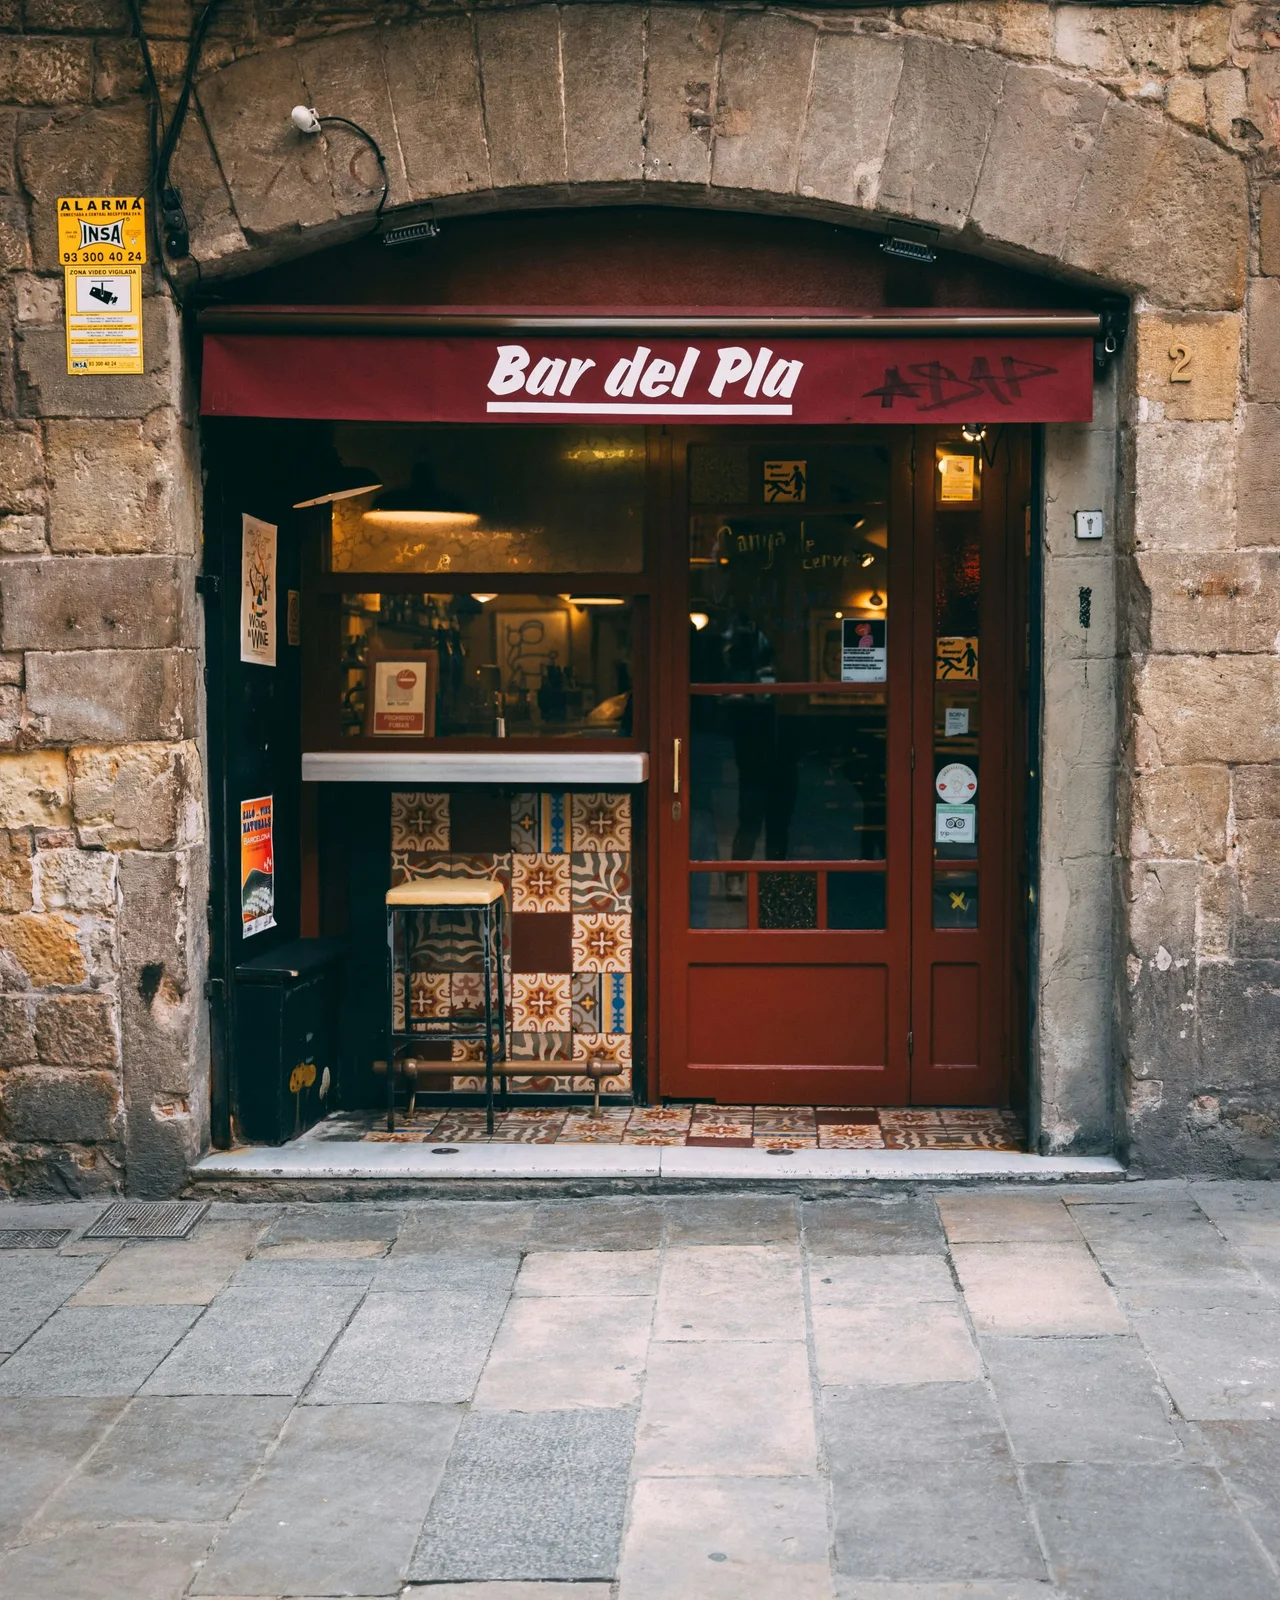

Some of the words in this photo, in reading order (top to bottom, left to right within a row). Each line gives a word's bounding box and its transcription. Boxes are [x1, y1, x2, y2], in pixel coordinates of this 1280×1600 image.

[61, 200, 142, 211] ALARMA
[83, 224, 120, 244] INSA
[64, 252, 77, 262] 93
[82, 252, 104, 262] 300
[109, 252, 122, 261] 40
[128, 252, 142, 261] 24
[487, 345, 596, 396] Bar
[604, 346, 701, 398] del
[708, 346, 804, 398] Pla
[1169, 343, 1192, 383] 2
[803, 553, 874, 570] cervea
[251, 629, 269, 649] WINE
[244, 832, 271, 846] BARCELONA
